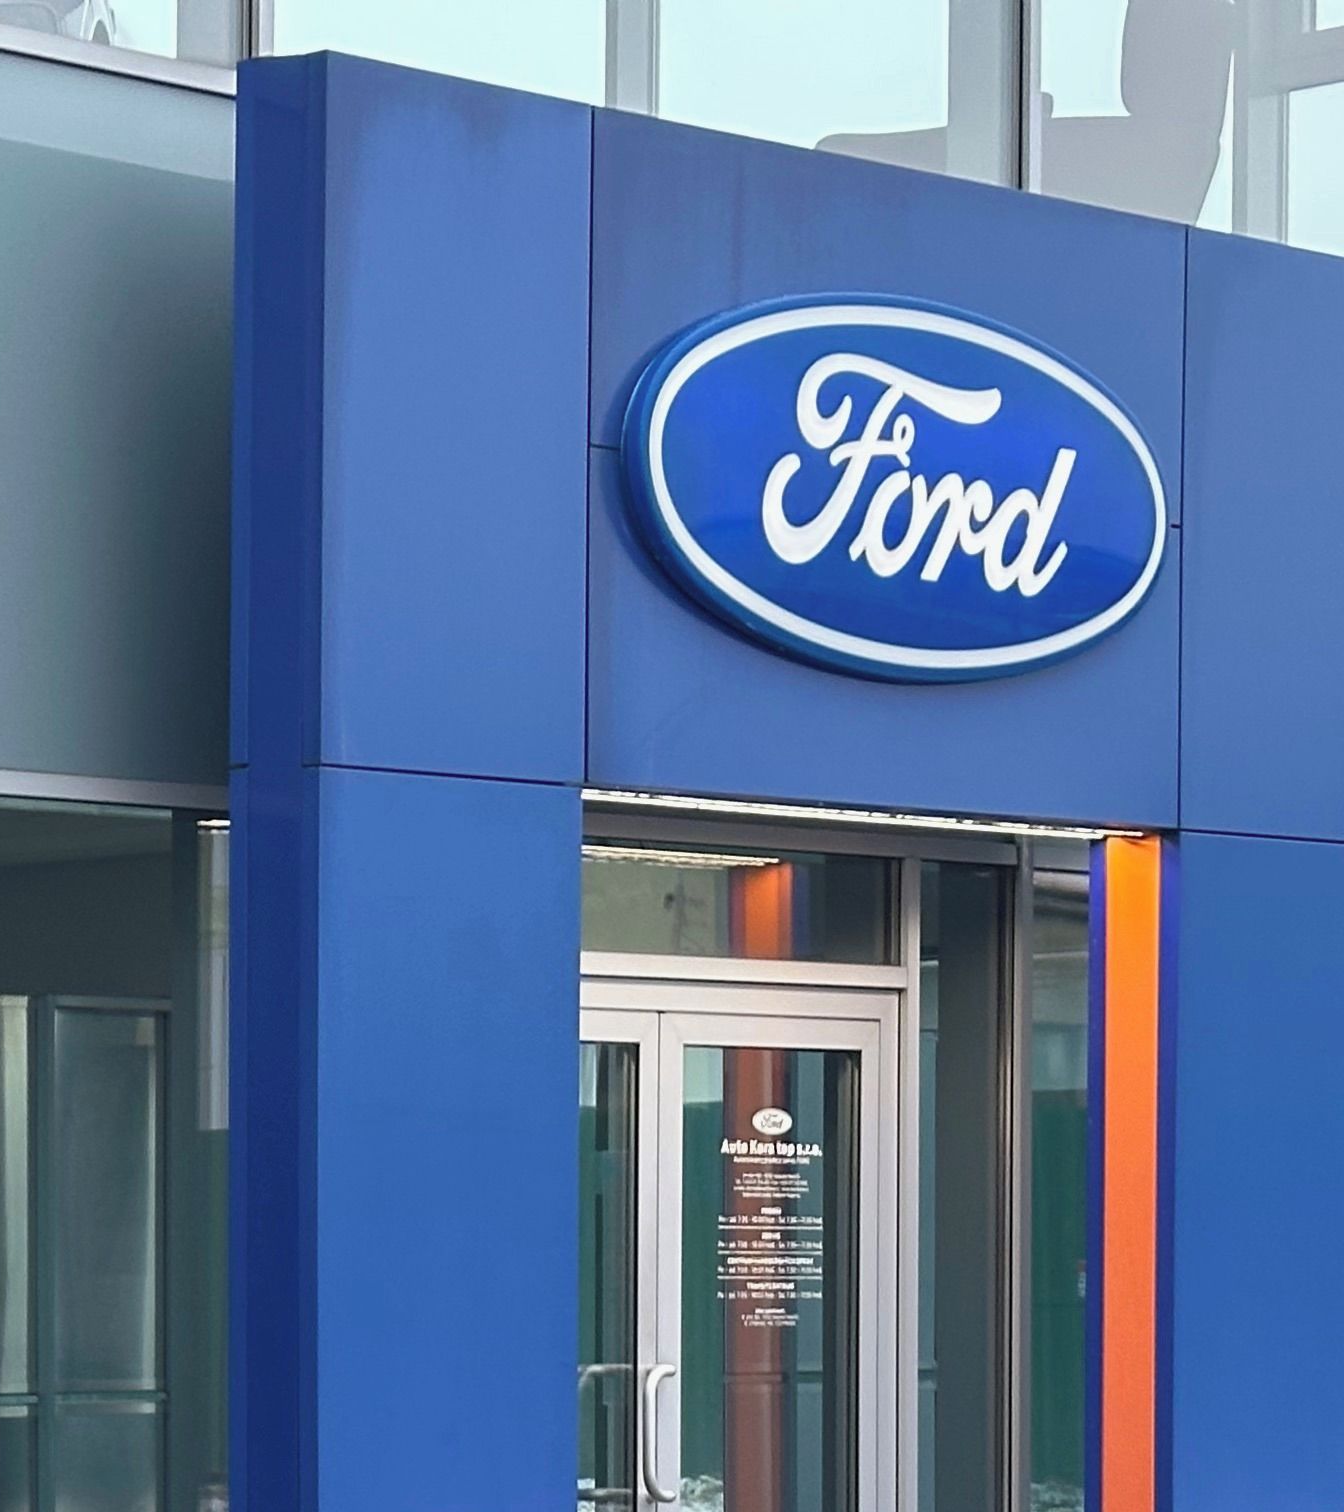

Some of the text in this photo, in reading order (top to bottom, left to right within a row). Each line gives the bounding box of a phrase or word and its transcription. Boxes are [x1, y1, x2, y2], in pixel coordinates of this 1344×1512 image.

[762, 351, 1077, 597] Ford
[720, 1138, 749, 1154] Auto
[749, 1139, 775, 1155] Kora
[776, 1141, 795, 1157] top
